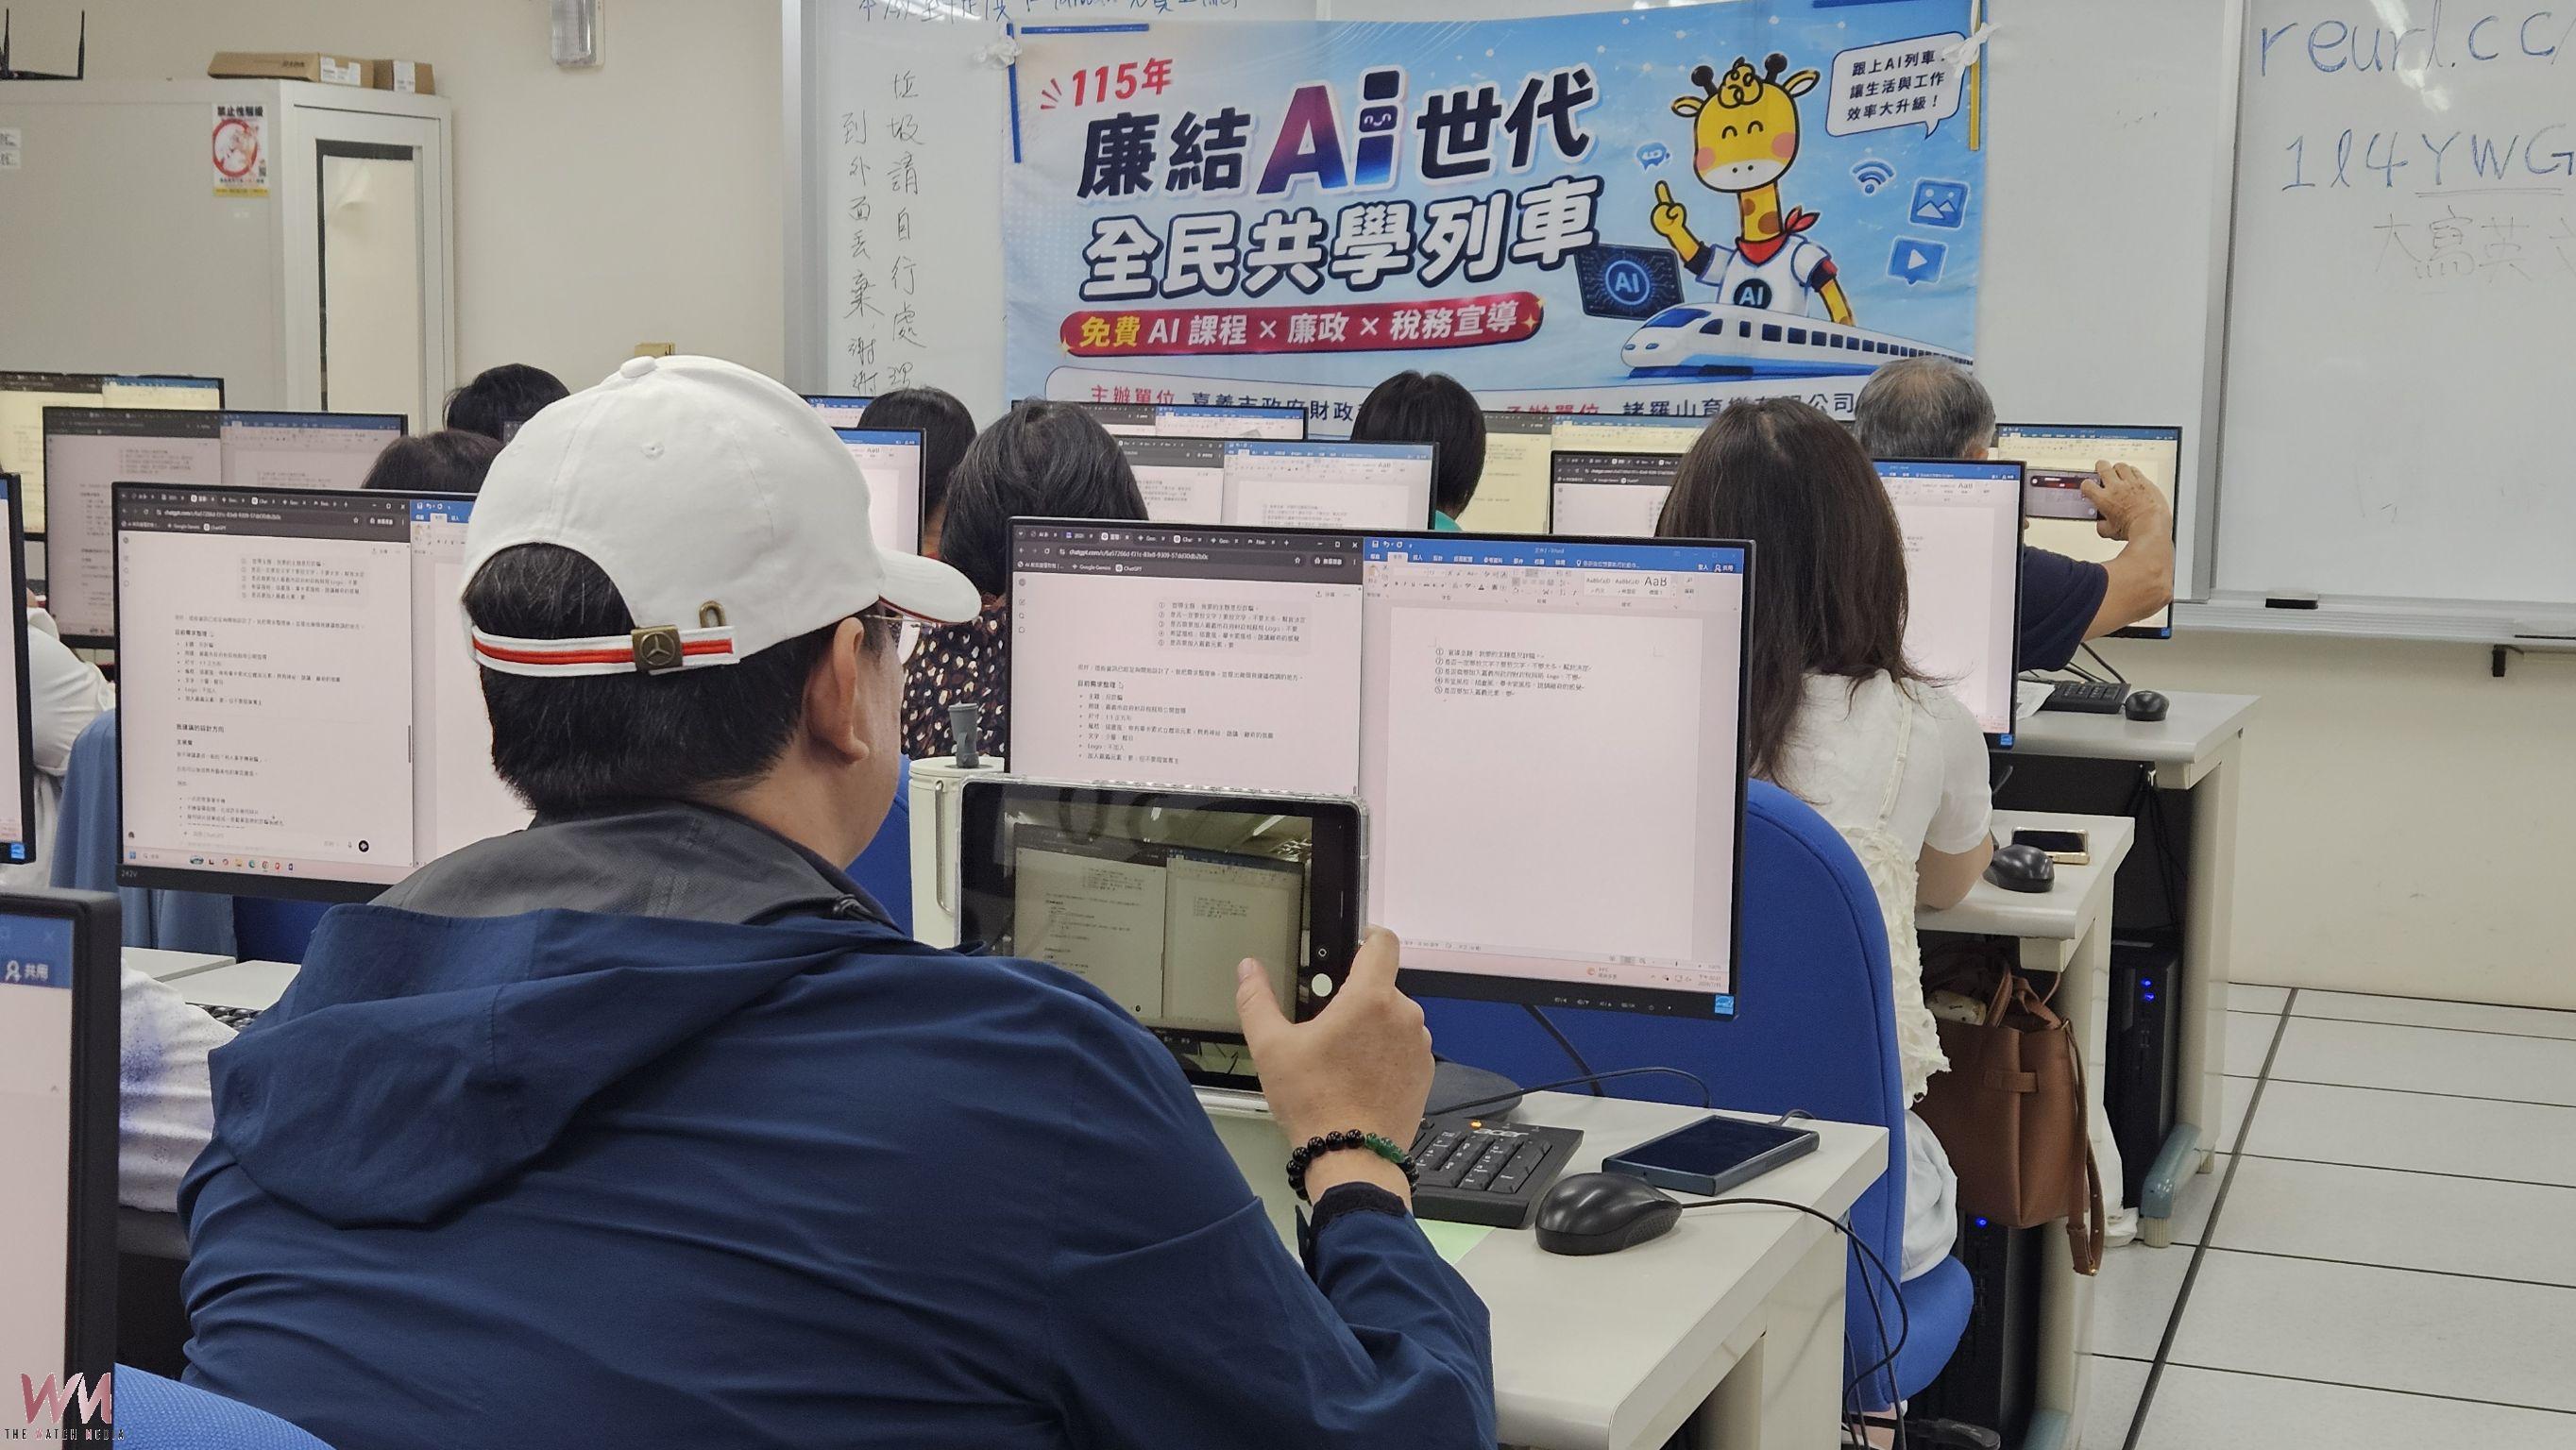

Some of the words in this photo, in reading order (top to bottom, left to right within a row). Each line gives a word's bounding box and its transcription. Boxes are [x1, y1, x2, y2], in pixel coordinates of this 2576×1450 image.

[1070, 58, 1173, 109] 115年
[1849, 72, 1945, 99] 讓生活與工作
[1847, 94, 1938, 121] 效率大升級！
[1079, 176, 1604, 301] 全民共學列車
[1614, 271, 1640, 295] AI
[1740, 286, 1764, 307] AI
[1079, 315, 1141, 347] 免費
[1147, 318, 1179, 345] AI
[1188, 314, 1248, 346] 課程
[1287, 312, 1347, 345] 廉政
[1389, 300, 1518, 341] 稅務宣導
[1091, 384, 1176, 404] 主辦單位
